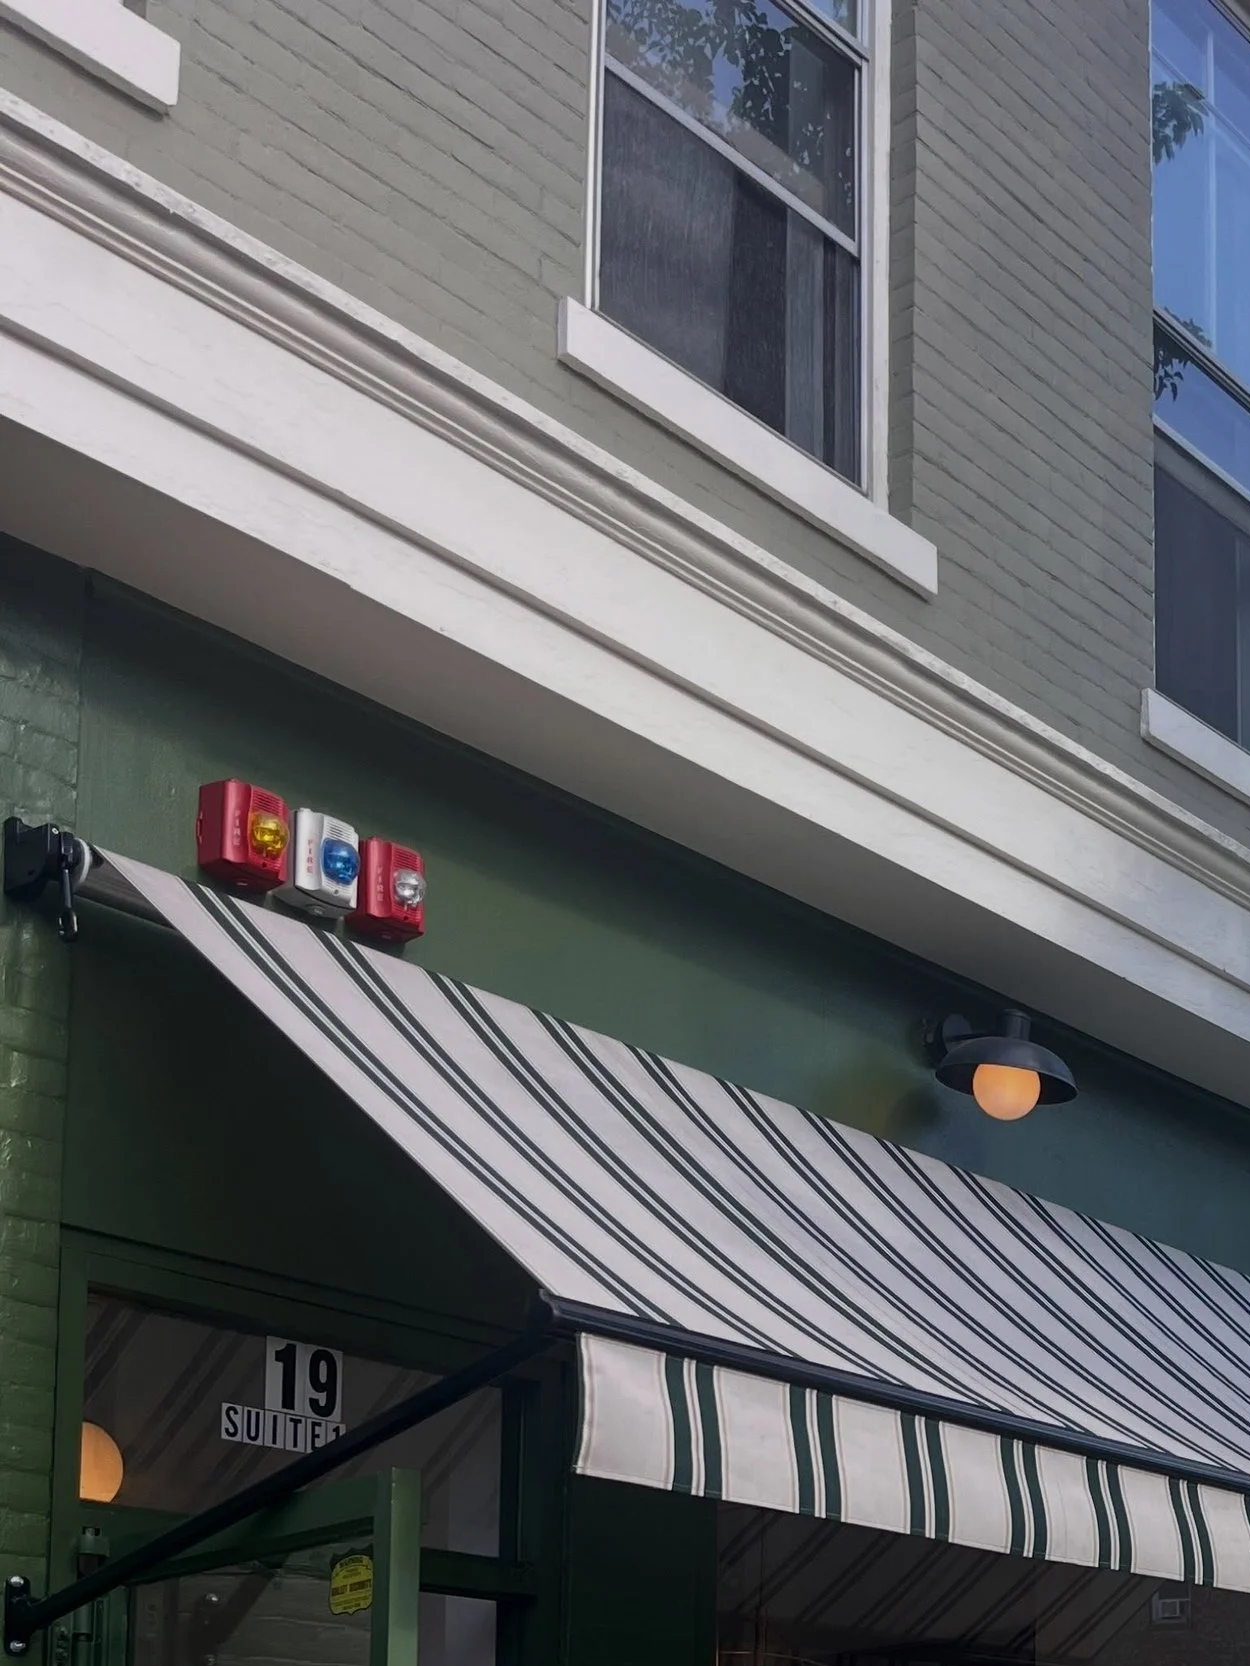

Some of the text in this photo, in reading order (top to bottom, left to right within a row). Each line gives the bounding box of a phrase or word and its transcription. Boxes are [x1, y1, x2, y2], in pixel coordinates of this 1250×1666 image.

[233, 809, 242, 847] FIRE
[306, 838, 314, 874] FIRE
[375, 864, 384, 902] FIRE
[274, 1343, 338, 1418] 19
